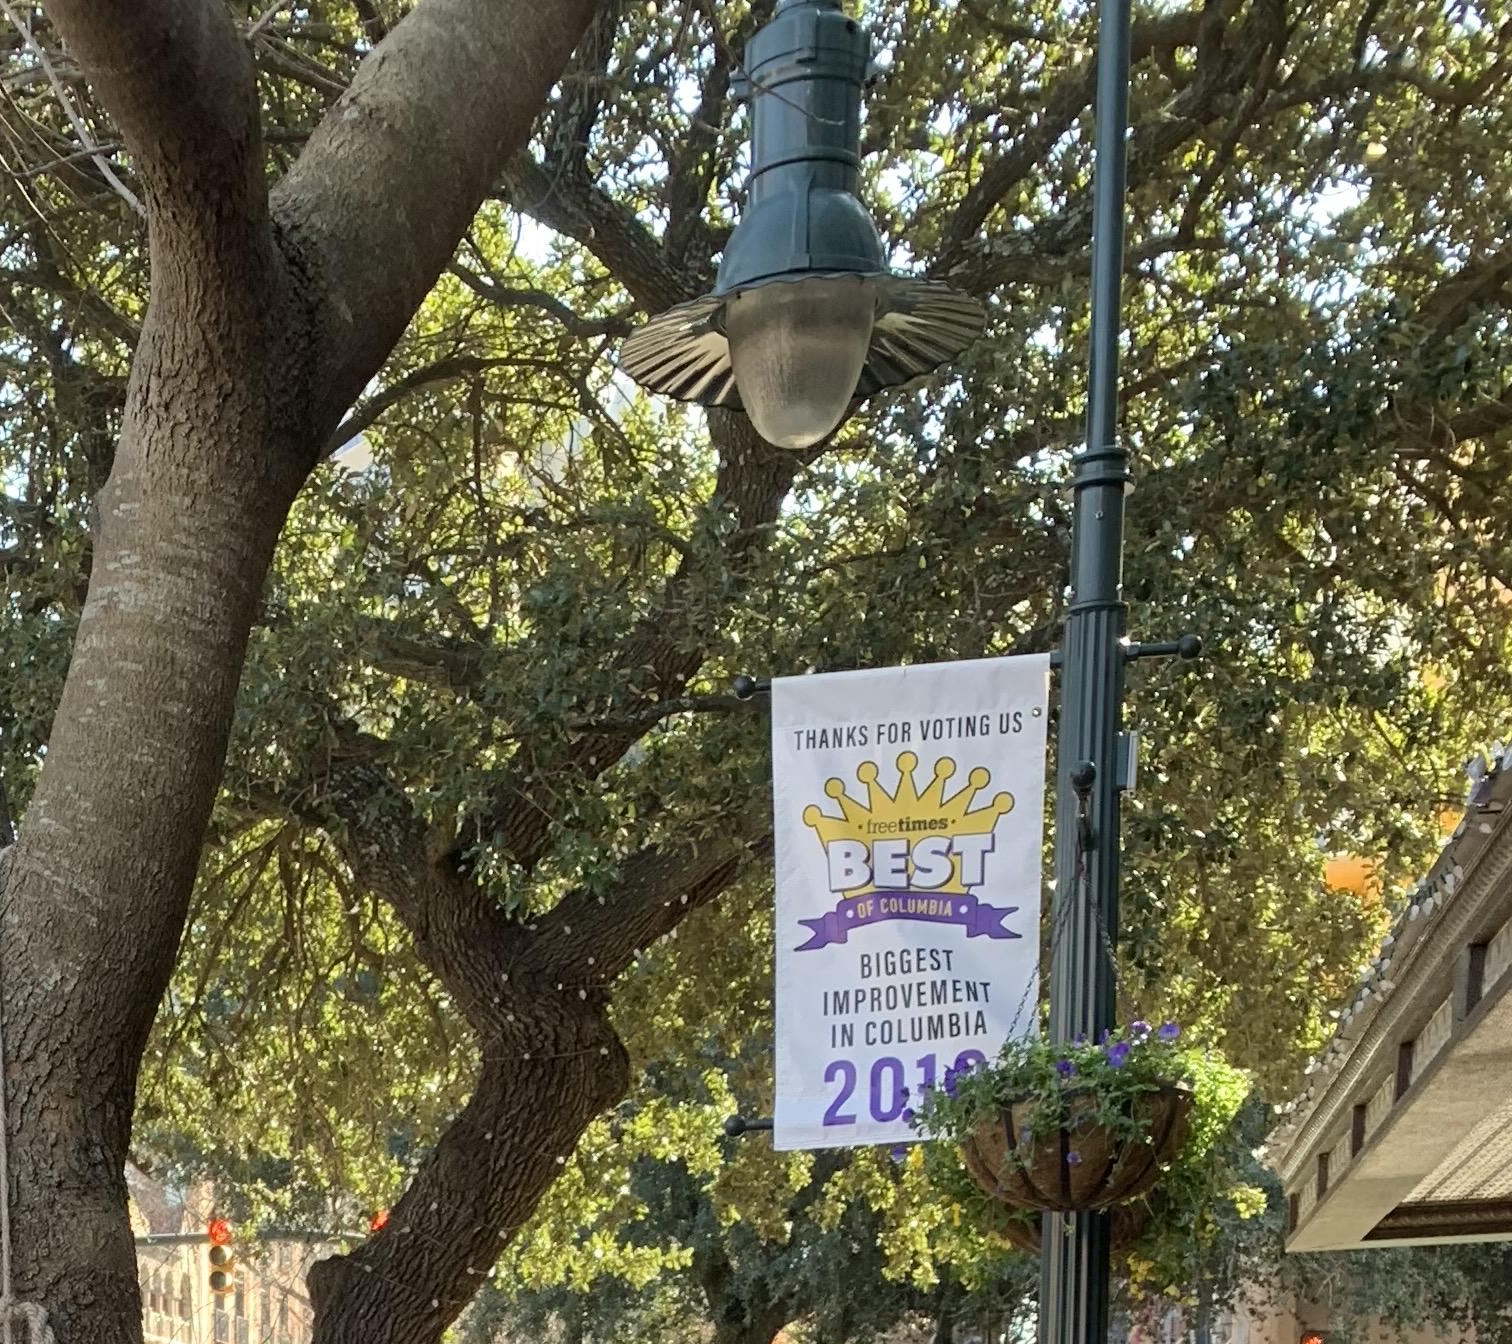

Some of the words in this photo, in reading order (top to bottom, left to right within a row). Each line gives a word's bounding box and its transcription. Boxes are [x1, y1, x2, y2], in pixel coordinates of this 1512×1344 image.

[794, 724, 868, 751] THANKS
[876, 721, 912, 745] FOR
[920, 714, 991, 742] VOTING
[999, 711, 1024, 735] US
[826, 832, 995, 893] BEST
[857, 900, 874, 919] OF
[880, 898, 953, 918] COLUMBIA
[860, 948, 954, 979] BIGGEST
[823, 979, 991, 1016] IMPROVEMENT
[831, 1023, 854, 1049] IN
[865, 1009, 988, 1046] COLUMBIA
